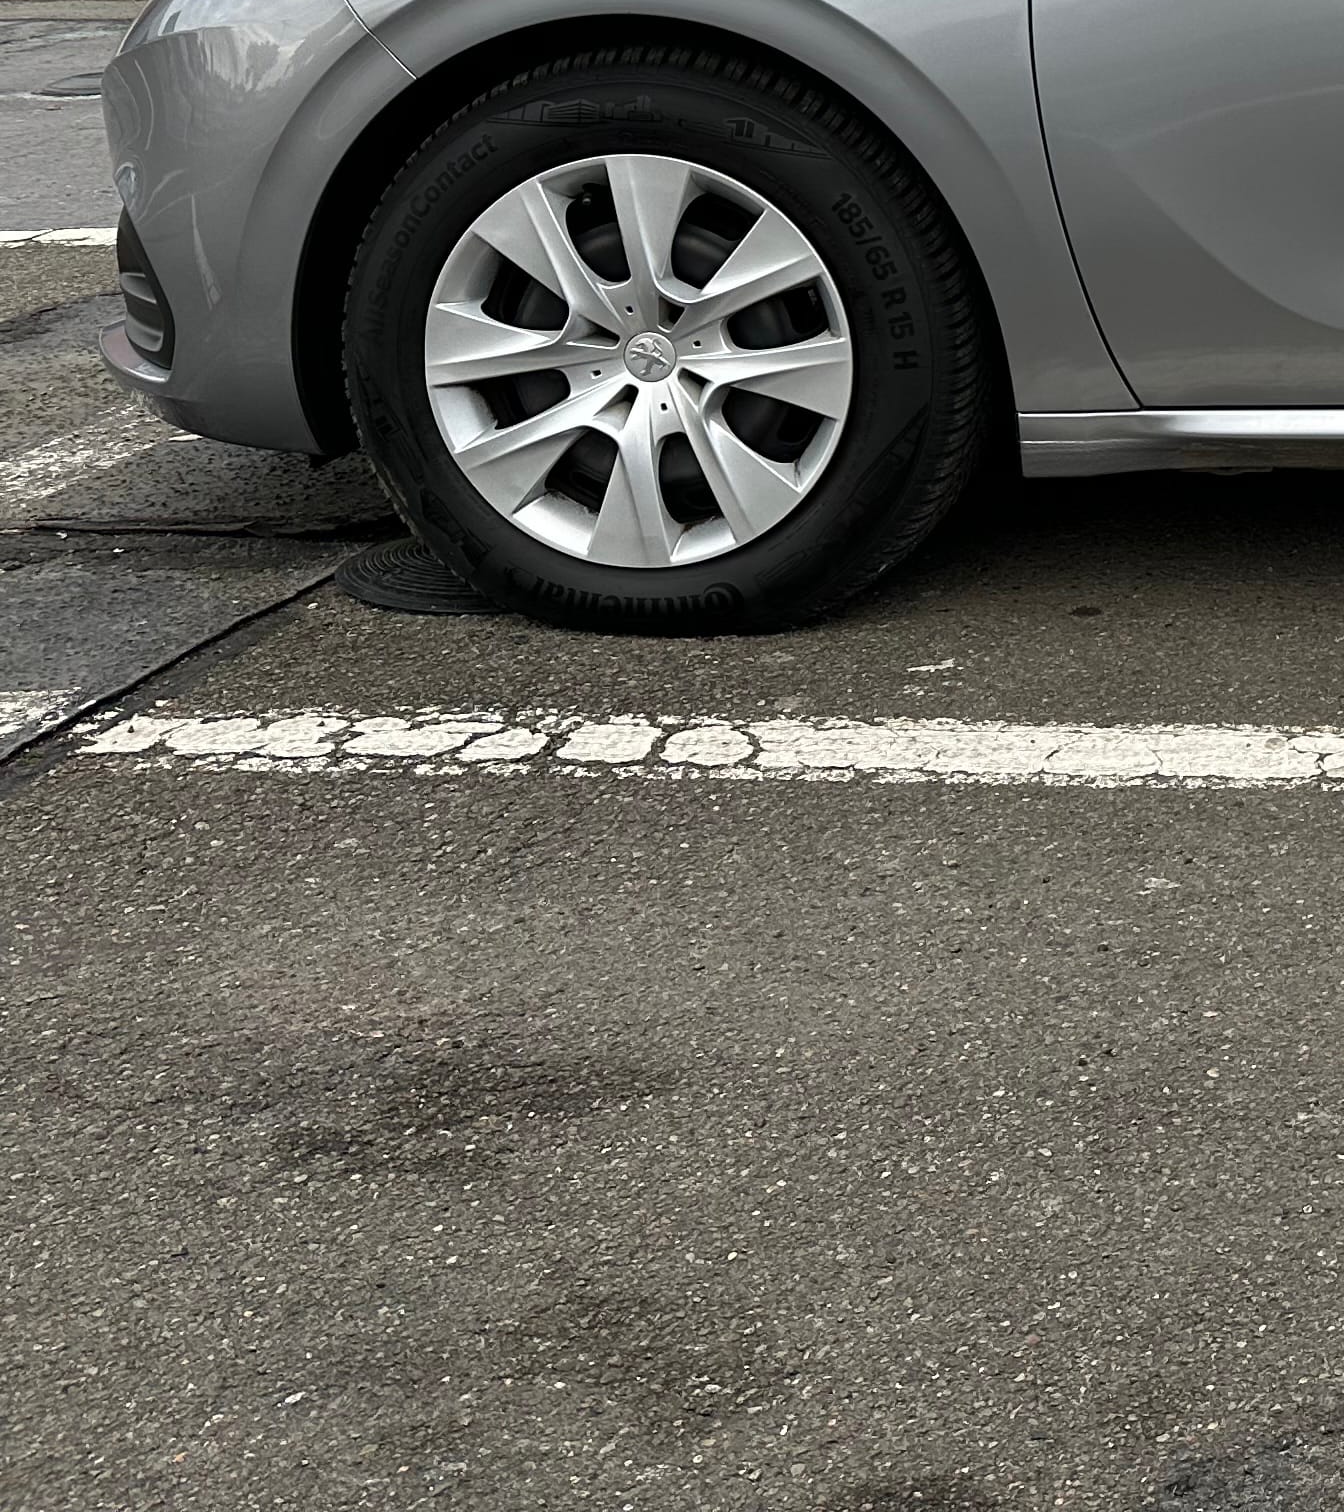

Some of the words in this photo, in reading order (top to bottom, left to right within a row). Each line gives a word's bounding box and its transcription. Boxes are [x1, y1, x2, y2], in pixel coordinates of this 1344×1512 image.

[831, 192, 897, 281] 185/65
[880, 286, 907, 310] R
[888, 311, 915, 340] 15
[893, 349, 919, 370] H
